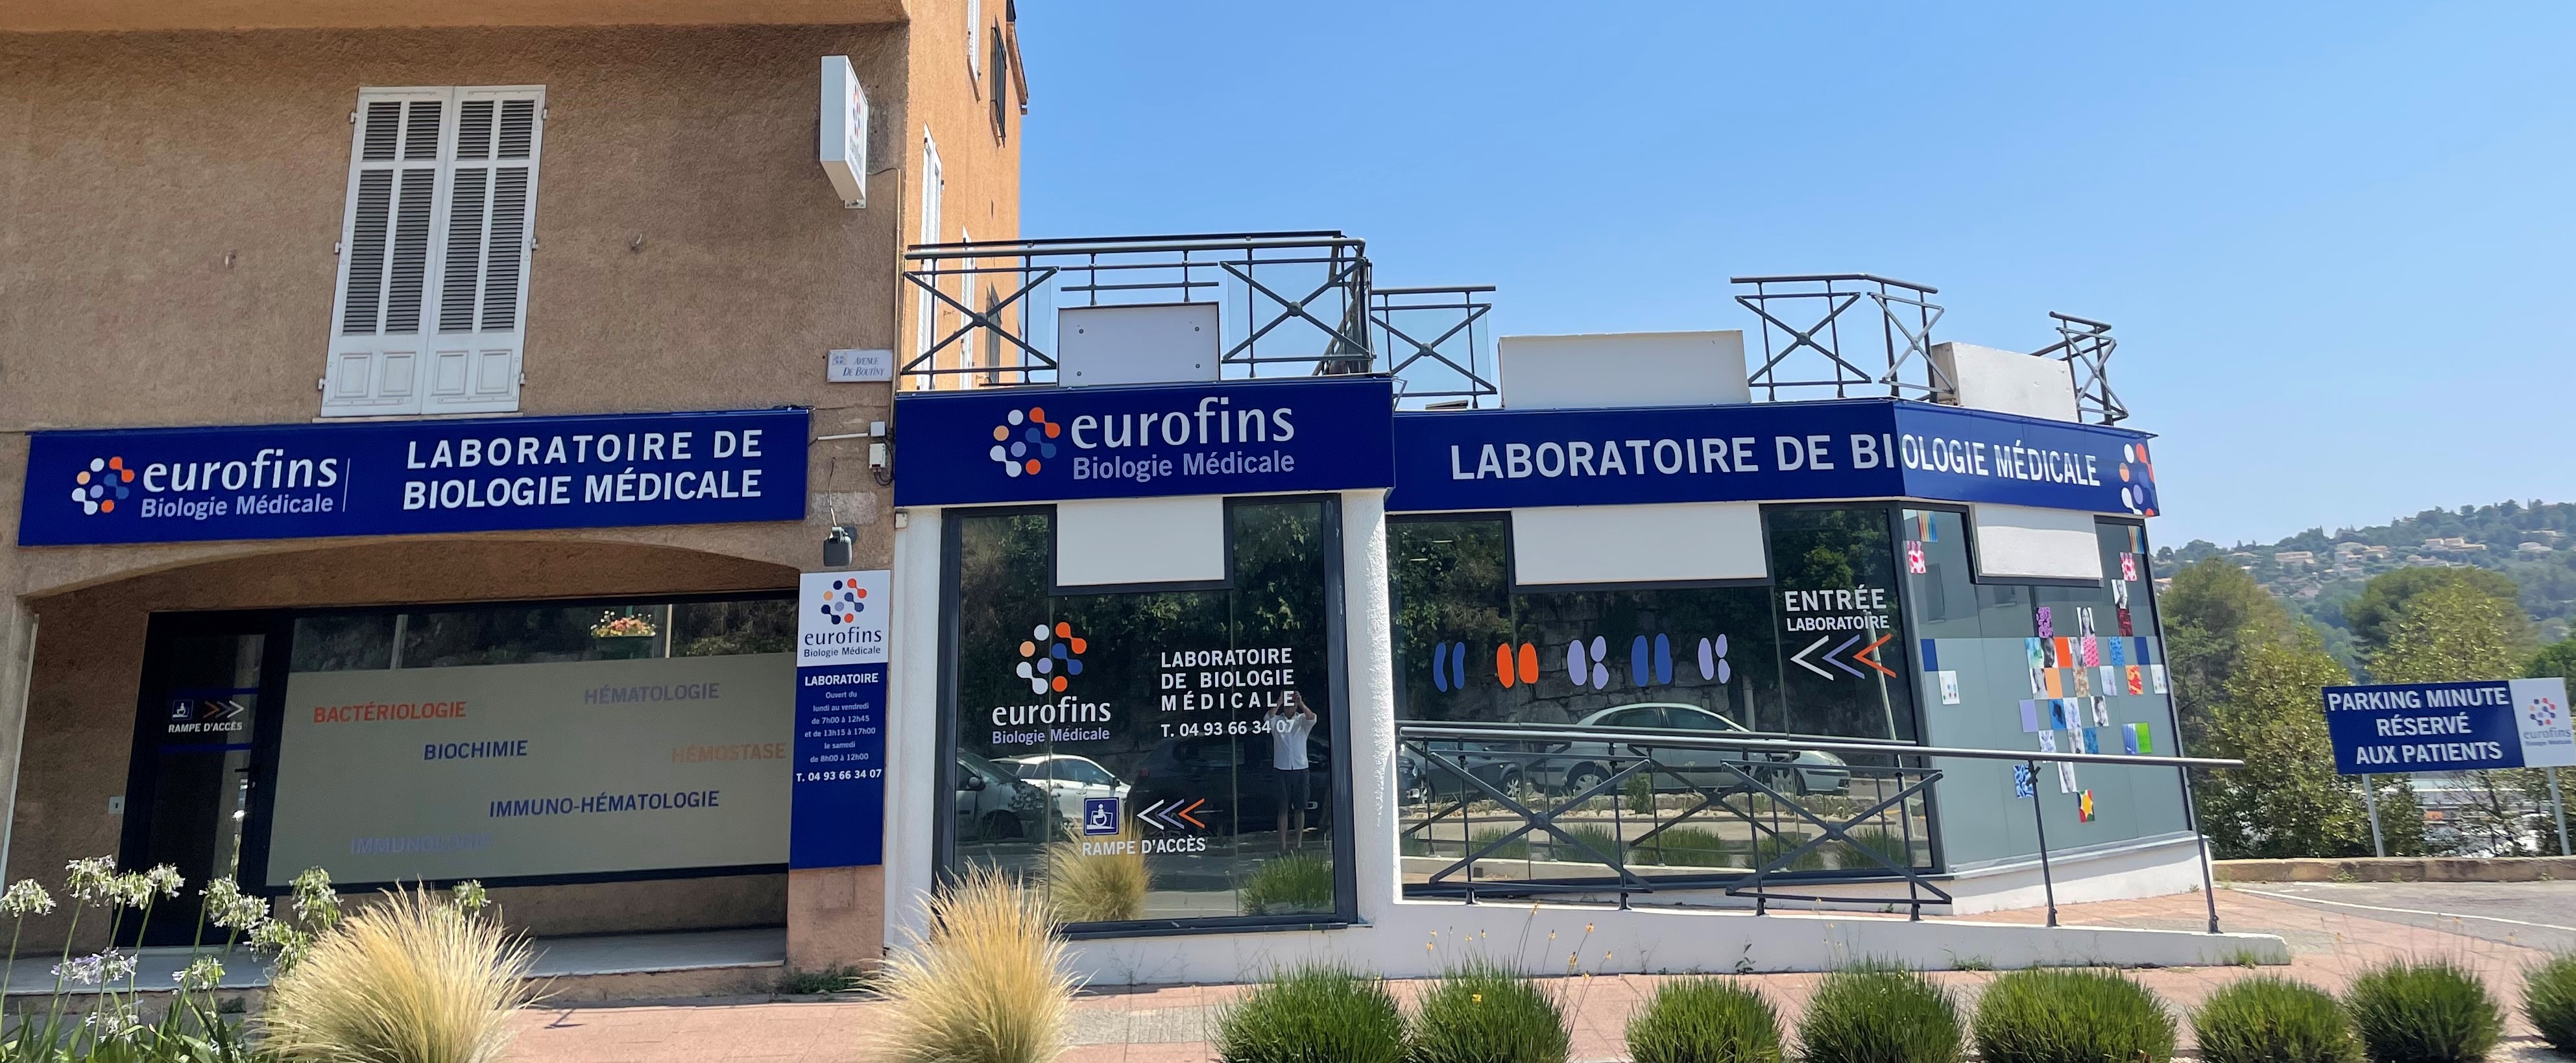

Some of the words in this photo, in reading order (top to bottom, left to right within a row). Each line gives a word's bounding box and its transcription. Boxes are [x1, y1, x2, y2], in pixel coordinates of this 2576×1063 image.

[1071, 397, 1295, 449] eurofins
[407, 431, 692, 469] LABORATOIRE
[713, 429, 762, 459] DE
[1451, 436, 1759, 480] LABORATOIRE
[1775, 435, 1835, 471] DE
[1850, 433, 1989, 476] BIOLOGIE
[1993, 439, 2101, 486] MÉDICALE
[143, 449, 337, 493] eurofins
[1074, 454, 1172, 483] Biologie
[1184, 450, 1295, 475] Médicale
[403, 475, 572, 510] BIOLOGIE
[584, 468, 762, 503] MÉDICALE
[141, 497, 227, 520] Biologie
[236, 493, 333, 515] Médicale
[1785, 584, 1887, 612] ENTRÉE
[1787, 615, 1890, 632] LABORATOIRE
[804, 627, 882, 645] eurofins
[804, 649, 838, 658] Biologie
[842, 646, 881, 655] Médicale
[1161, 648, 1292, 667] LABORATOIRE
[805, 673, 878, 686] LABORATOIRE
[1161, 673, 1186, 689] DE
[1201, 669, 1294, 688] BIOLOGIE
[584, 682, 719, 705] HÉMATOLOGIE
[1161, 690, 1294, 711] MÉDICALE
[2328, 690, 2421, 711] PARKING
[2426, 687, 2509, 707] MINUTE
[313, 701, 467, 724] BACTÉRIOLOGIE
[992, 696, 1111, 726] eurofins
[168, 723, 201, 733] RAMPE
[204, 721, 243, 732] D'ACCÈS
[1161, 724, 1174, 737] T.
[1179, 723, 1198, 737] 04
[1203, 722, 1223, 735] 93
[1228, 721, 1247, 735] 66
[1252, 720, 1271, 734] 34
[1276, 719, 1295, 733] 07
[2376, 712, 2472, 737] RÉSERVÉ
[2523, 727, 2571, 739] eurofins
[993, 730, 1044, 745] Biologie
[1050, 727, 1110, 742] Médicale
[424, 739, 528, 760] BIOCHIMIE
[671, 742, 786, 763] HÉMOSTASE
[2356, 745, 2398, 764] AUX
[2401, 741, 2503, 763] PATIENTS
[796, 773, 805, 782] T.
[808, 772, 820, 781] 04
[823, 771, 836, 780] 93
[839, 770, 851, 780] 66
[854, 770, 867, 779] 34
[869, 769, 882, 778] 07
[490, 790, 719, 817] IMMUNO-HÉMATOLOGIE
[1082, 841, 1135, 856] RAMPE
[1142, 835, 1205, 854] D'ACCÈS
